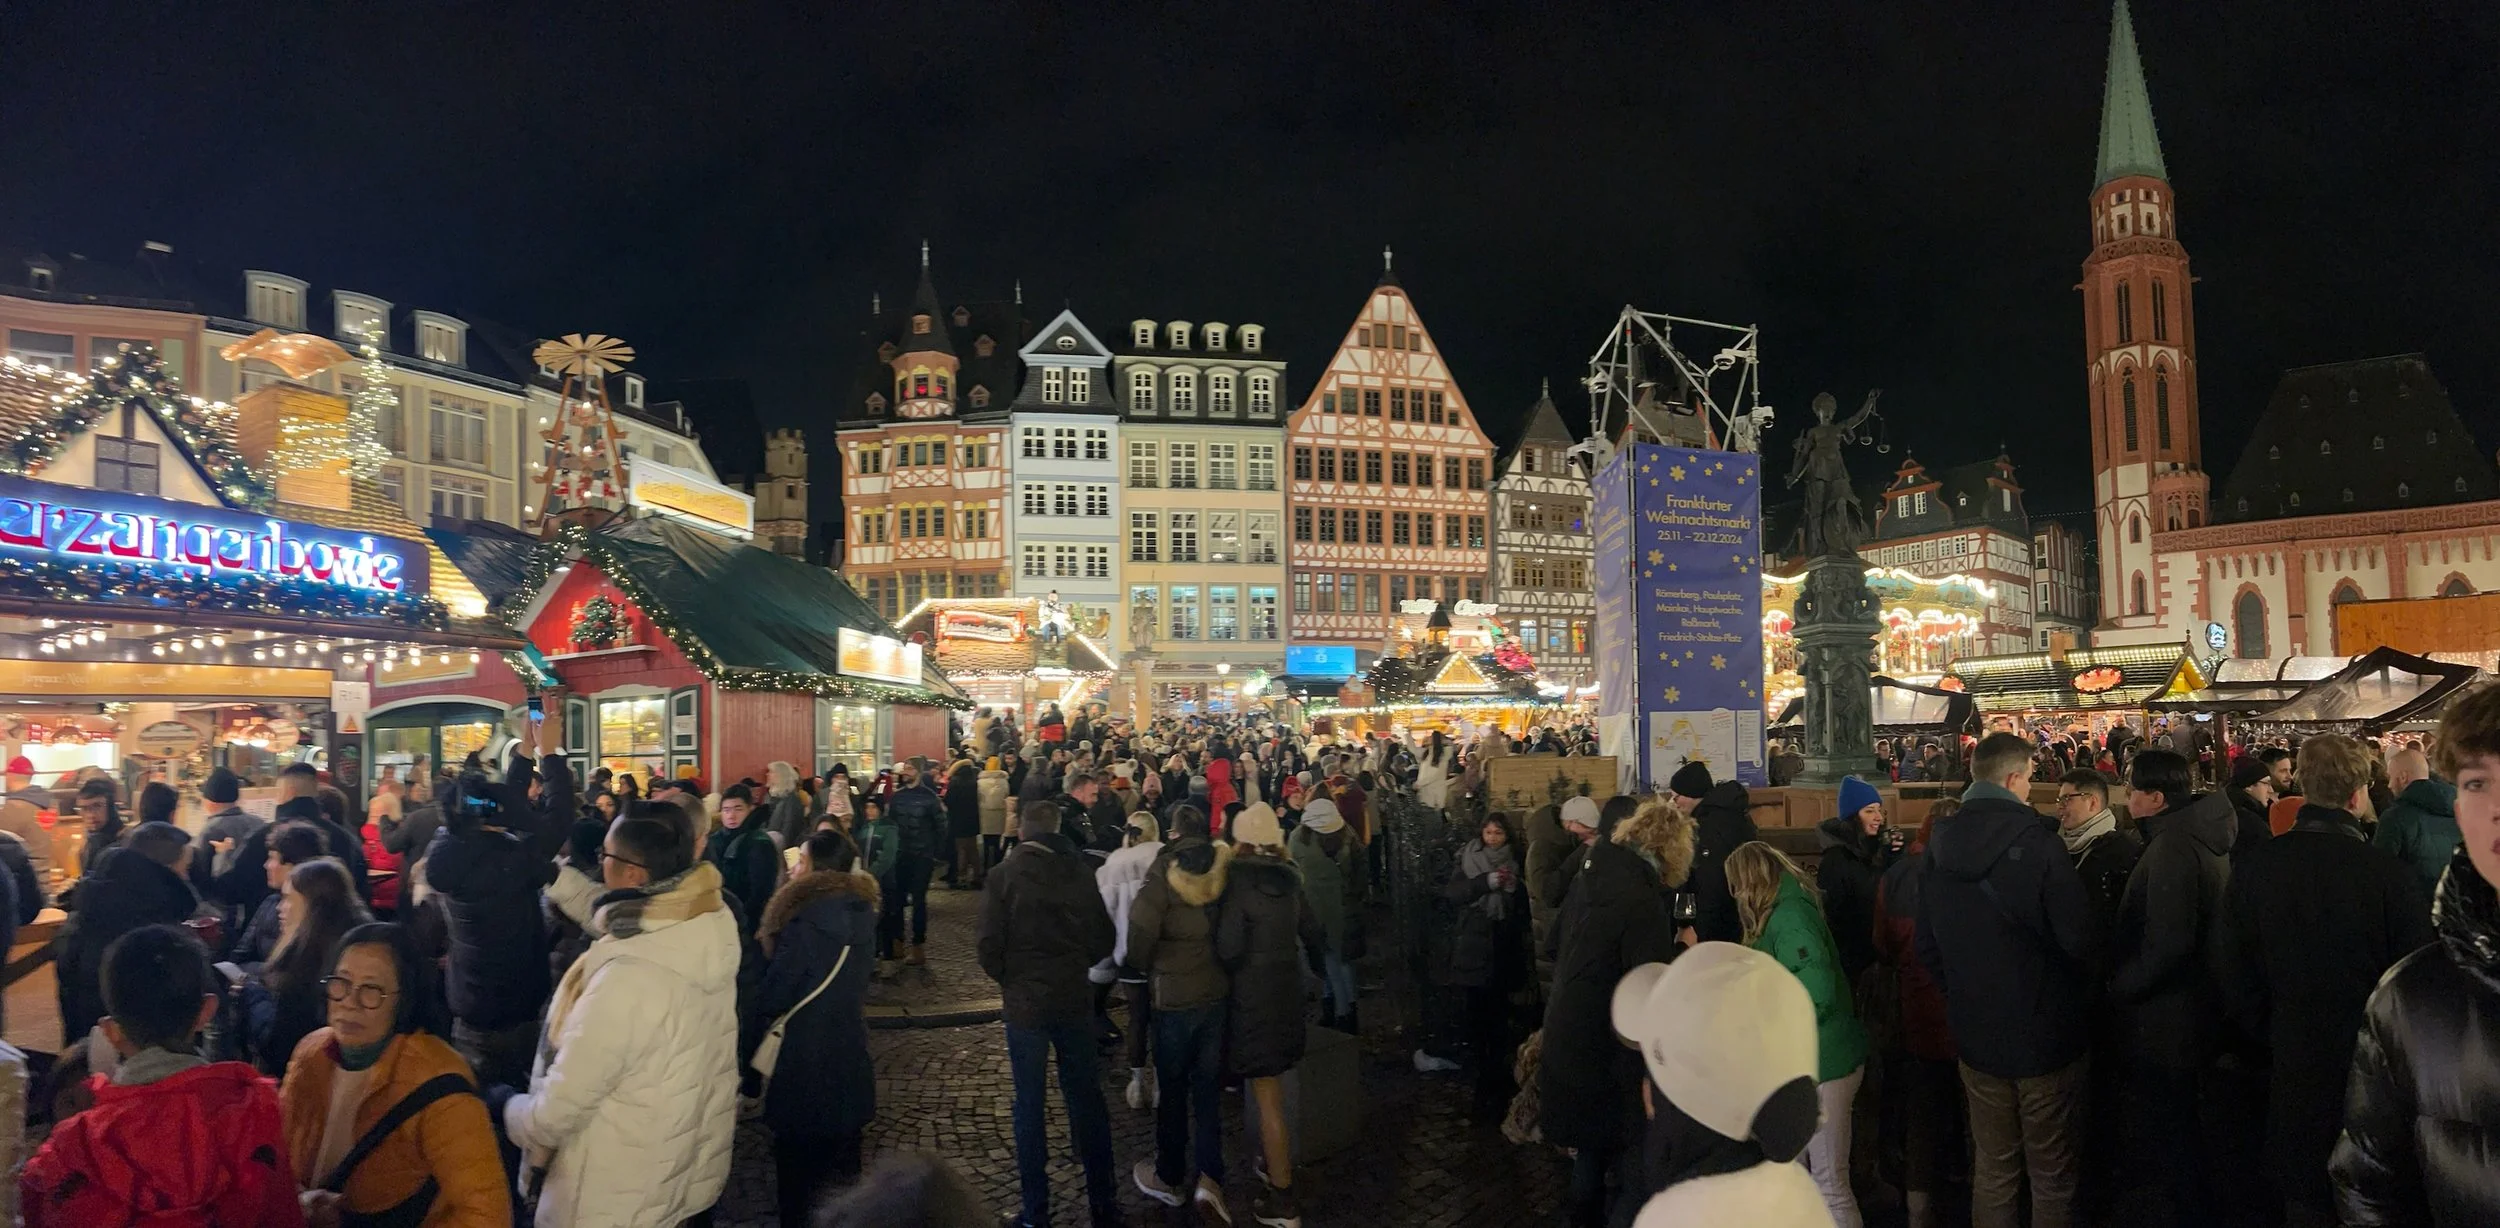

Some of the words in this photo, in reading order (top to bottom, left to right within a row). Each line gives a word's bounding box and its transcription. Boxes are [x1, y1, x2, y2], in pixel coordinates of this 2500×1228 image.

[1667, 494, 1732, 511] Frankfurter
[1646, 509, 1750, 529] Weihnachtsmarkt
[1658, 530, 1683, 542] 25.11.
[1693, 532, 1742, 544] 22.12.2024
[1656, 588, 1702, 602] Römerberg,
[1703, 590, 1744, 603] Paulsplatz,
[1656, 602, 1692, 614] Mainkai,
[1693, 604, 1744, 616] Hauptwache,
[1681, 617, 1721, 629] Roßmarkt,
[1658, 631, 1743, 643] Friedrich-Stoltze-Platz
